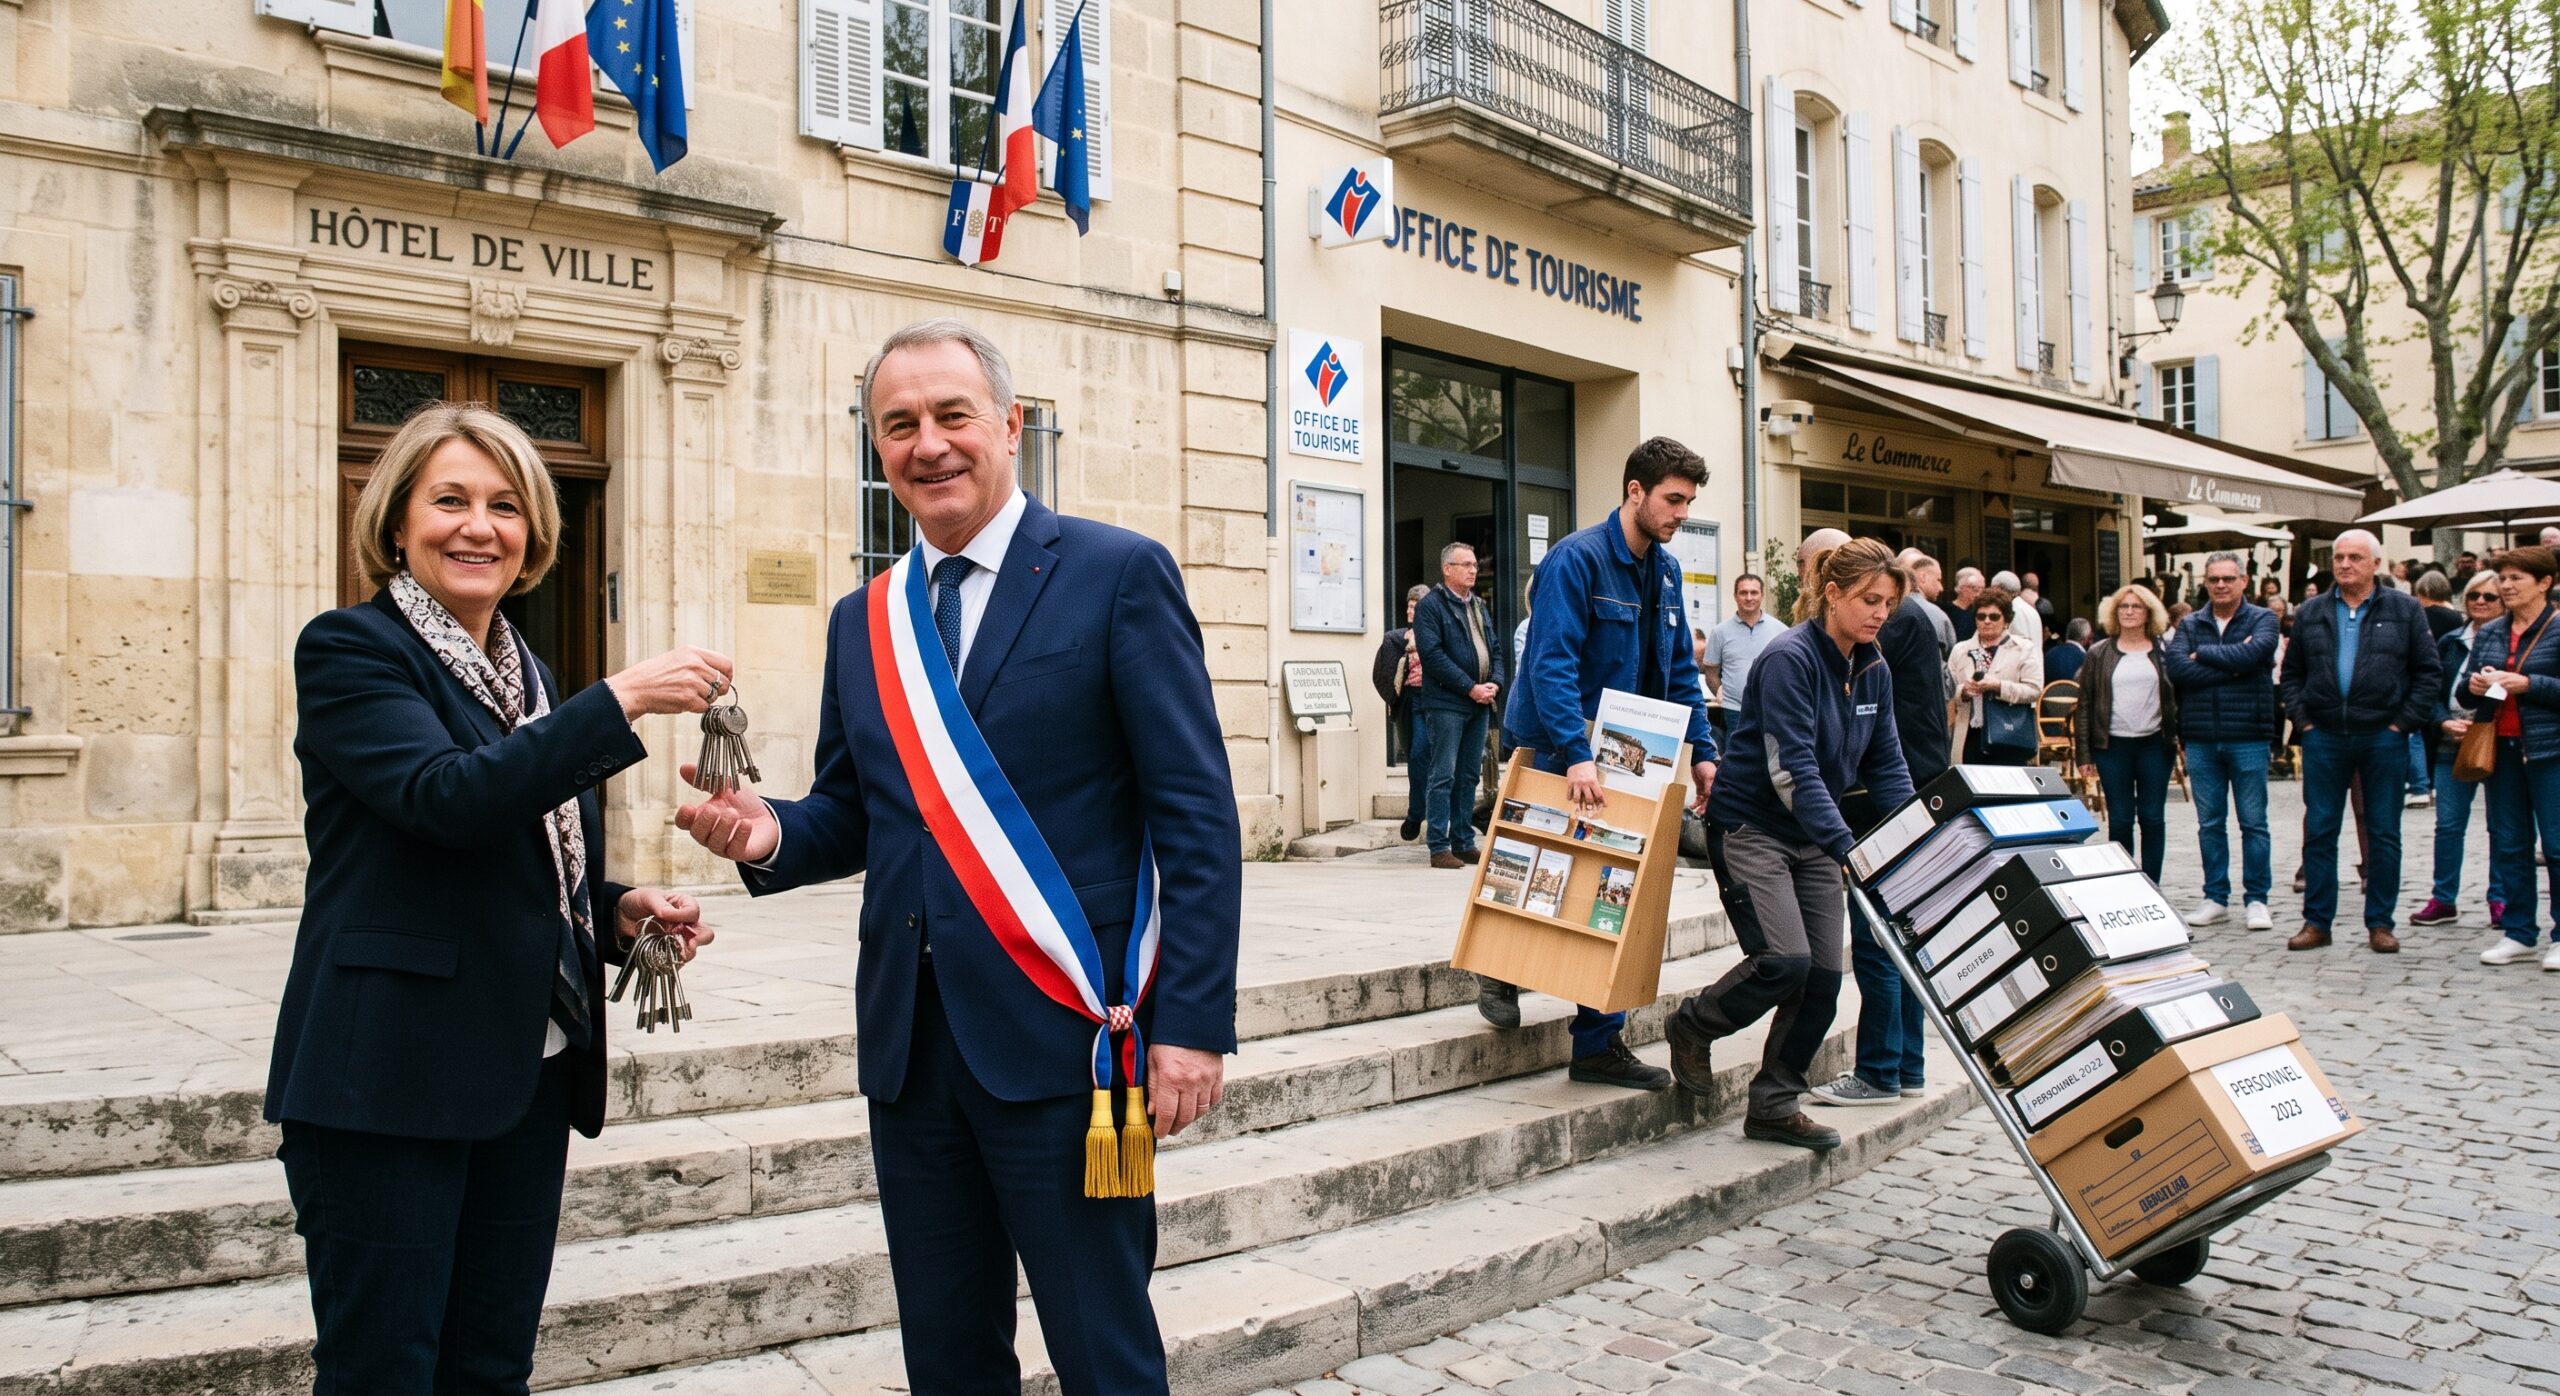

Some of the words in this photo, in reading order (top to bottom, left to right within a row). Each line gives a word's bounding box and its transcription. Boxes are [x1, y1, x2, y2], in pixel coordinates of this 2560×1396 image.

[951, 208, 965, 226] F
[988, 216, 1002, 233] T
[310, 206, 454, 263] HÔTEL
[471, 232, 525, 273] DE
[540, 243, 654, 292] VILLE
[1486, 234, 1520, 286] DE
[1525, 247, 1642, 323] TOURISME
[1294, 409, 1339, 432] OFFICE
[1343, 417, 1359, 435] DE
[1294, 430, 1360, 455] TOURISME
[1842, 432, 1866, 462] Le
[1871, 435, 1953, 474] Commerce
[2187, 474, 2203, 500] Le
[2098, 904, 2166, 930] ARCHIVES
[2079, 1057, 2104, 1079] 2022
[2229, 1064, 2303, 1098] PERSONNEL
[2271, 1098, 2303, 1122] 2023
